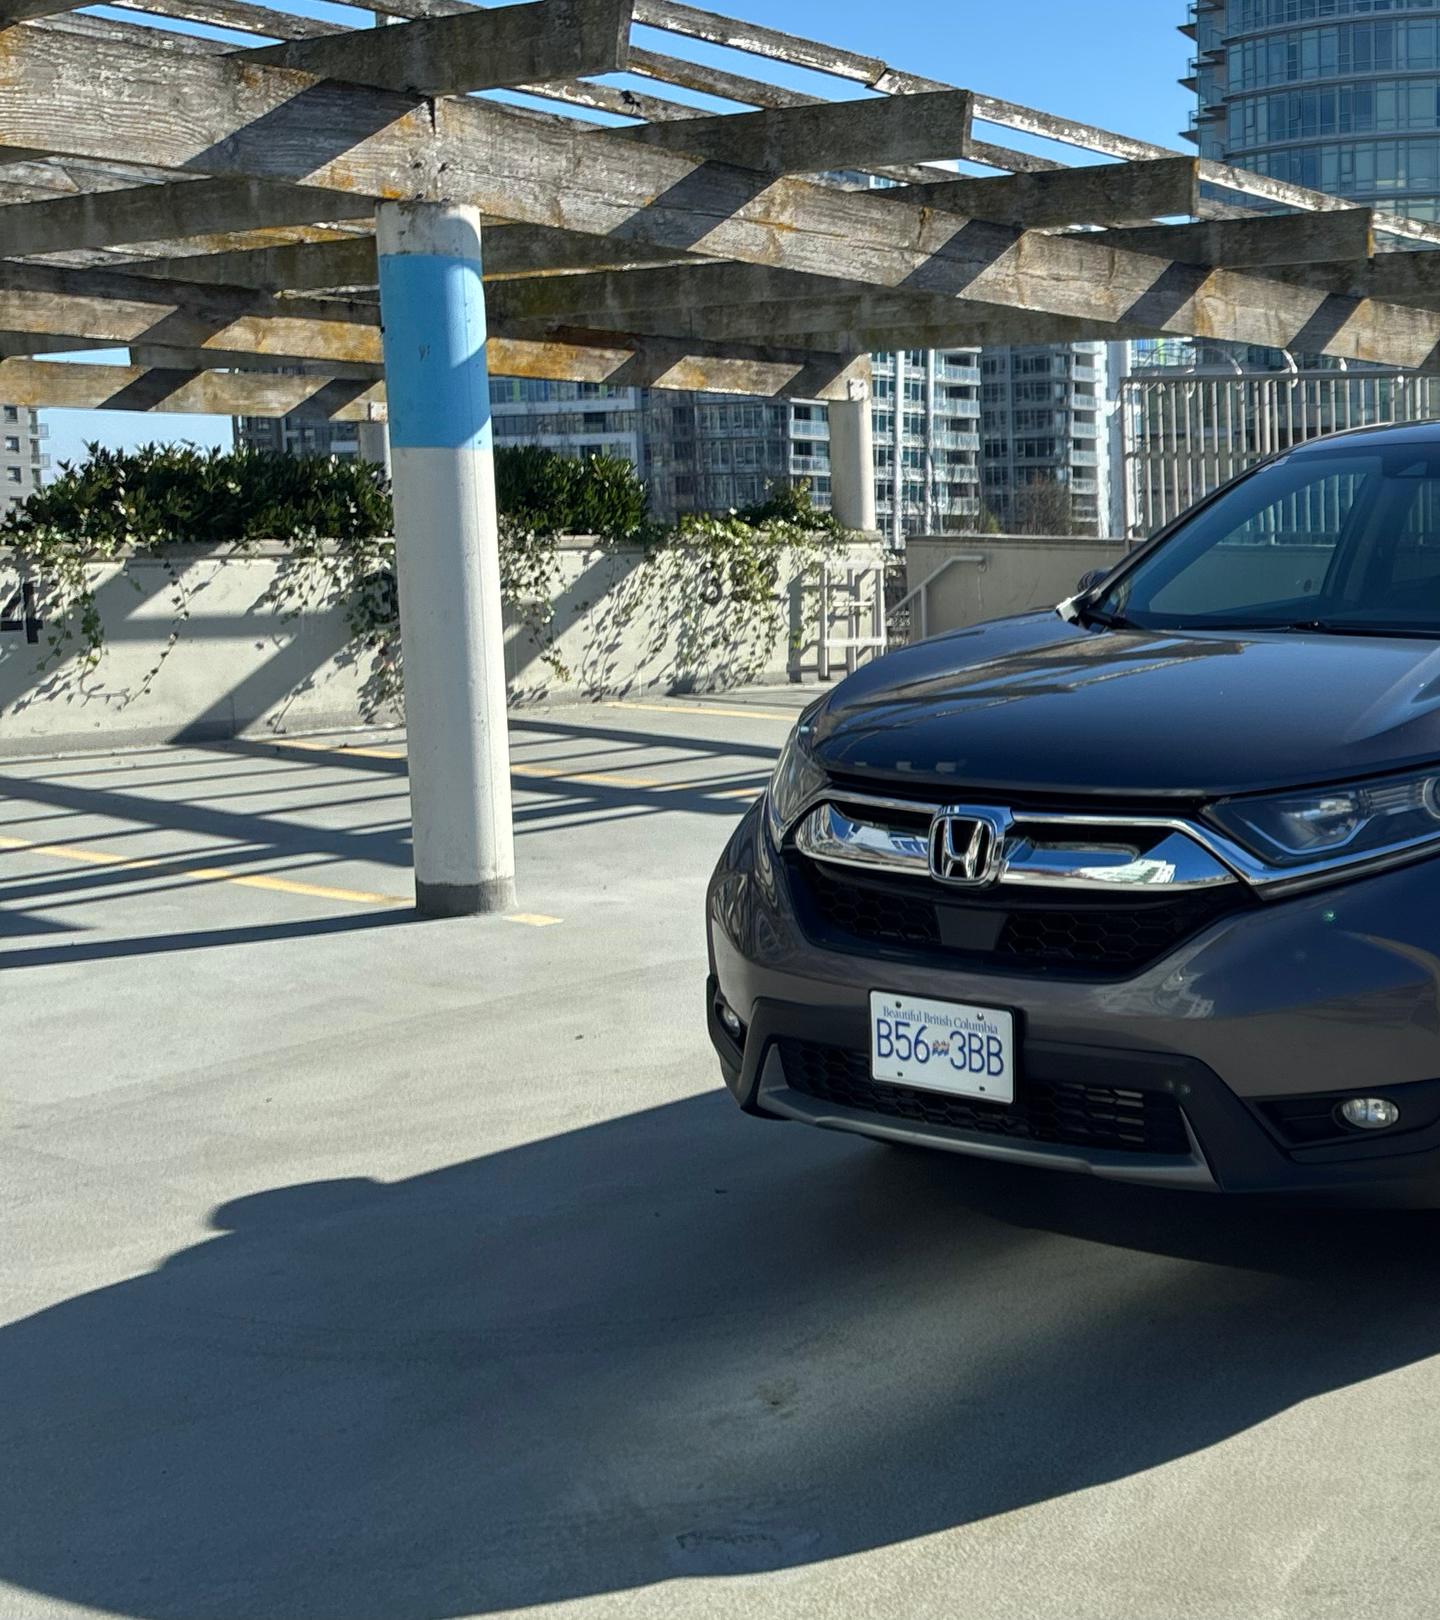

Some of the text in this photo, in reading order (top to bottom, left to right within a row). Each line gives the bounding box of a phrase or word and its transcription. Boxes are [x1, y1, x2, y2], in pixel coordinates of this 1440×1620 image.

[883, 1005, 999, 1035] Beautiful British Columbia
[876, 1018, 1005, 1077] B56 3BB
